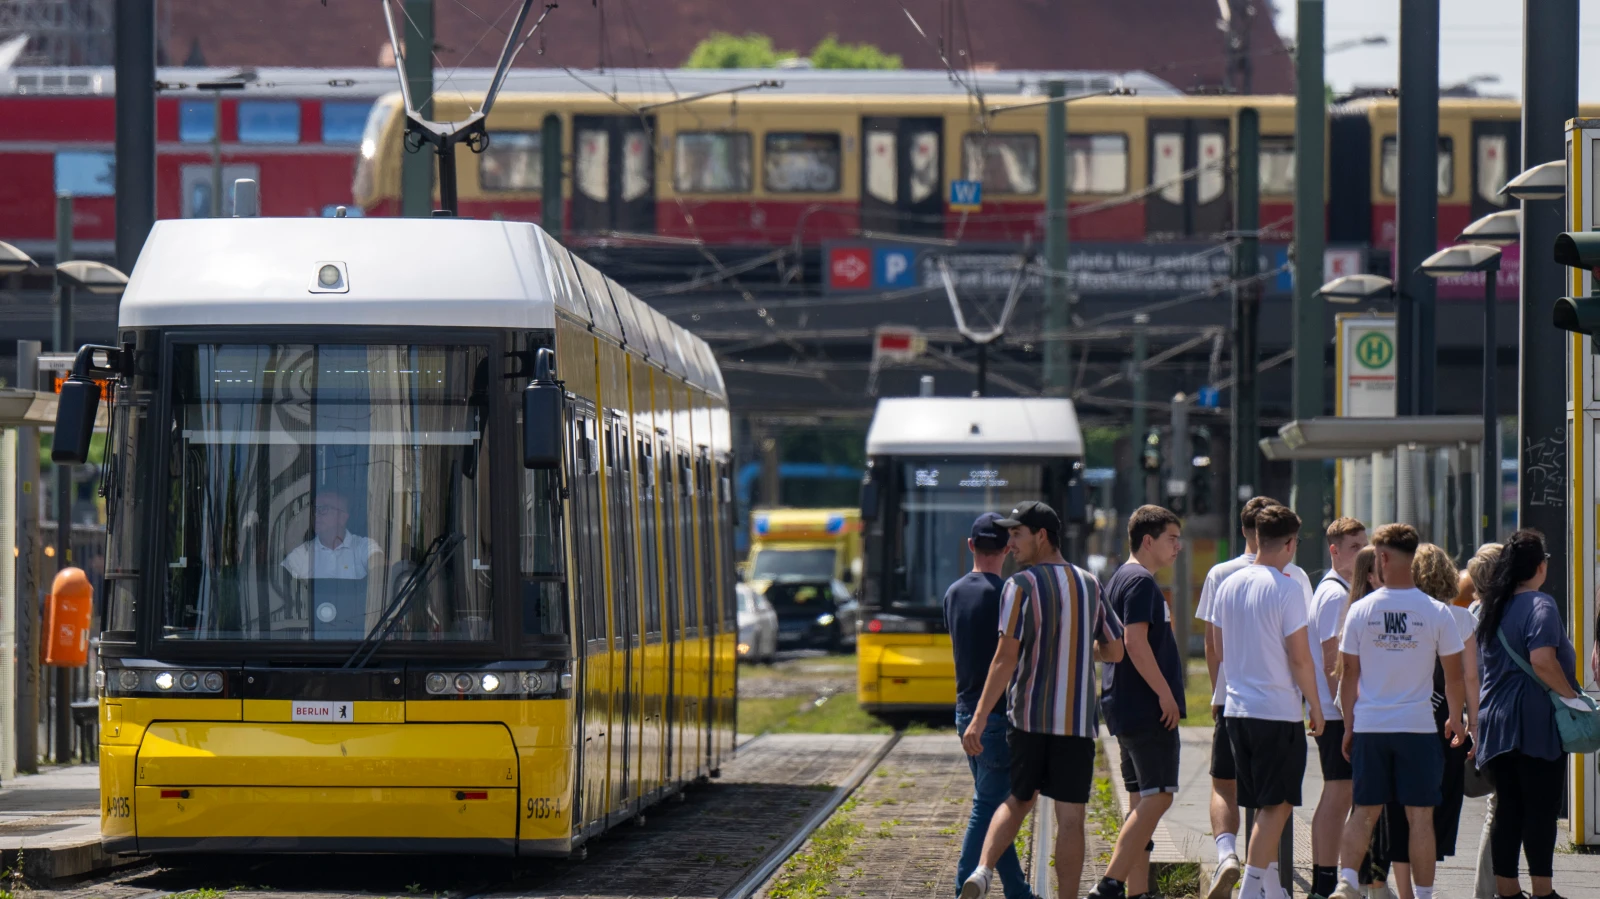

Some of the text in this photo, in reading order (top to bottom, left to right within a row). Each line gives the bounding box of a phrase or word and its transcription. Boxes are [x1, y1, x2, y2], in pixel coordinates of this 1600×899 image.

[955, 183, 978, 204] W
[885, 253, 908, 283] P
[1366, 341, 1384, 361] H
[1384, 612, 1407, 634] VANS
[296, 707, 329, 716] BERLIN
